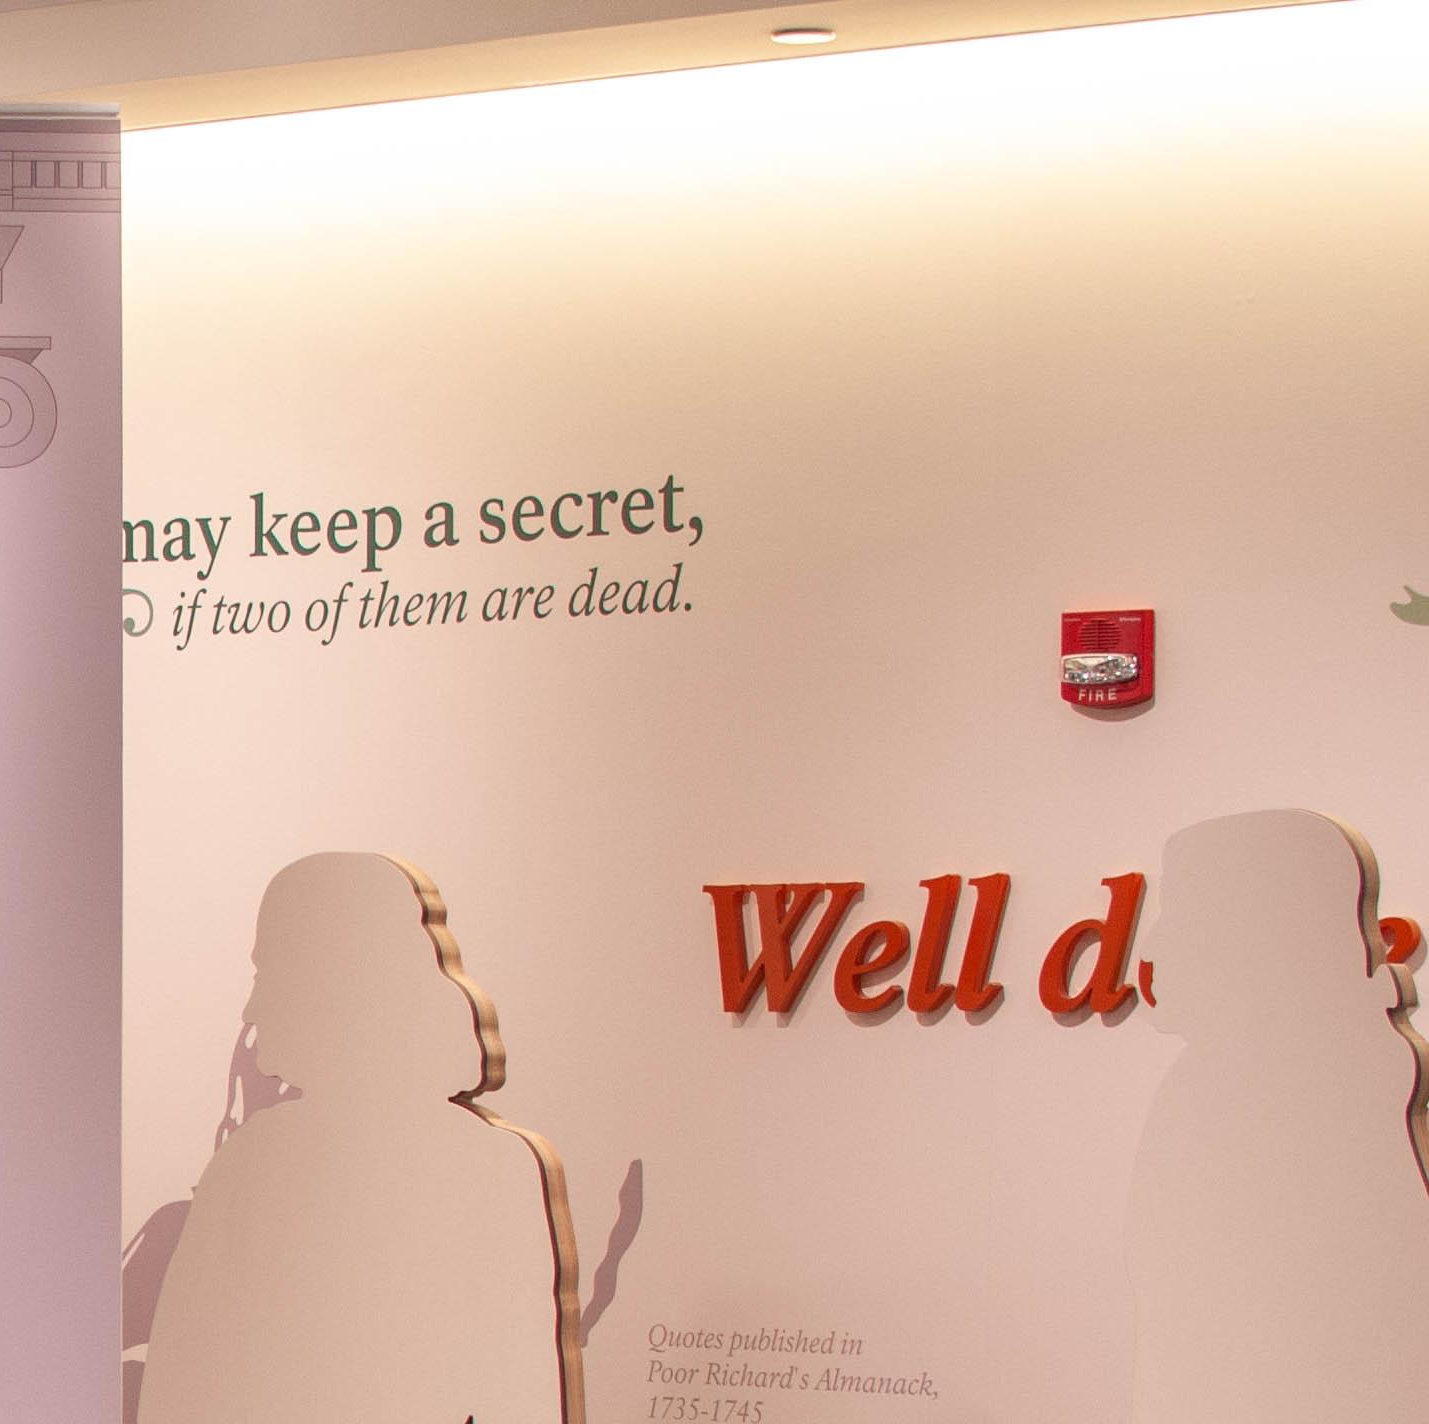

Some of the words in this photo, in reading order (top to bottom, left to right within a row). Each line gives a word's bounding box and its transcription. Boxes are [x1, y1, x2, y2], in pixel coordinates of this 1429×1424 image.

[249, 492, 403, 572] keep
[423, 502, 459, 548] a
[479, 474, 704, 546] secret,
[171, 588, 207, 650] if
[211, 592, 291, 636] two
[305, 582, 352, 646] of
[358, 580, 466, 630] them
[482, 583, 555, 622] are
[568, 562, 693, 616] dead.
[1078, 689, 1117, 702] FIRE
[702, 870, 1012, 1016] Well
[648, 1324, 724, 1353] Quotes
[730, 1328, 836, 1357] published
[839, 1330, 863, 1357] in
[646, 1359, 699, 1386] Poor
[704, 1361, 810, 1391] Richard's
[814, 1367, 939, 1399] Almanack,
[646, 1396, 764, 1424] 1735-1745
